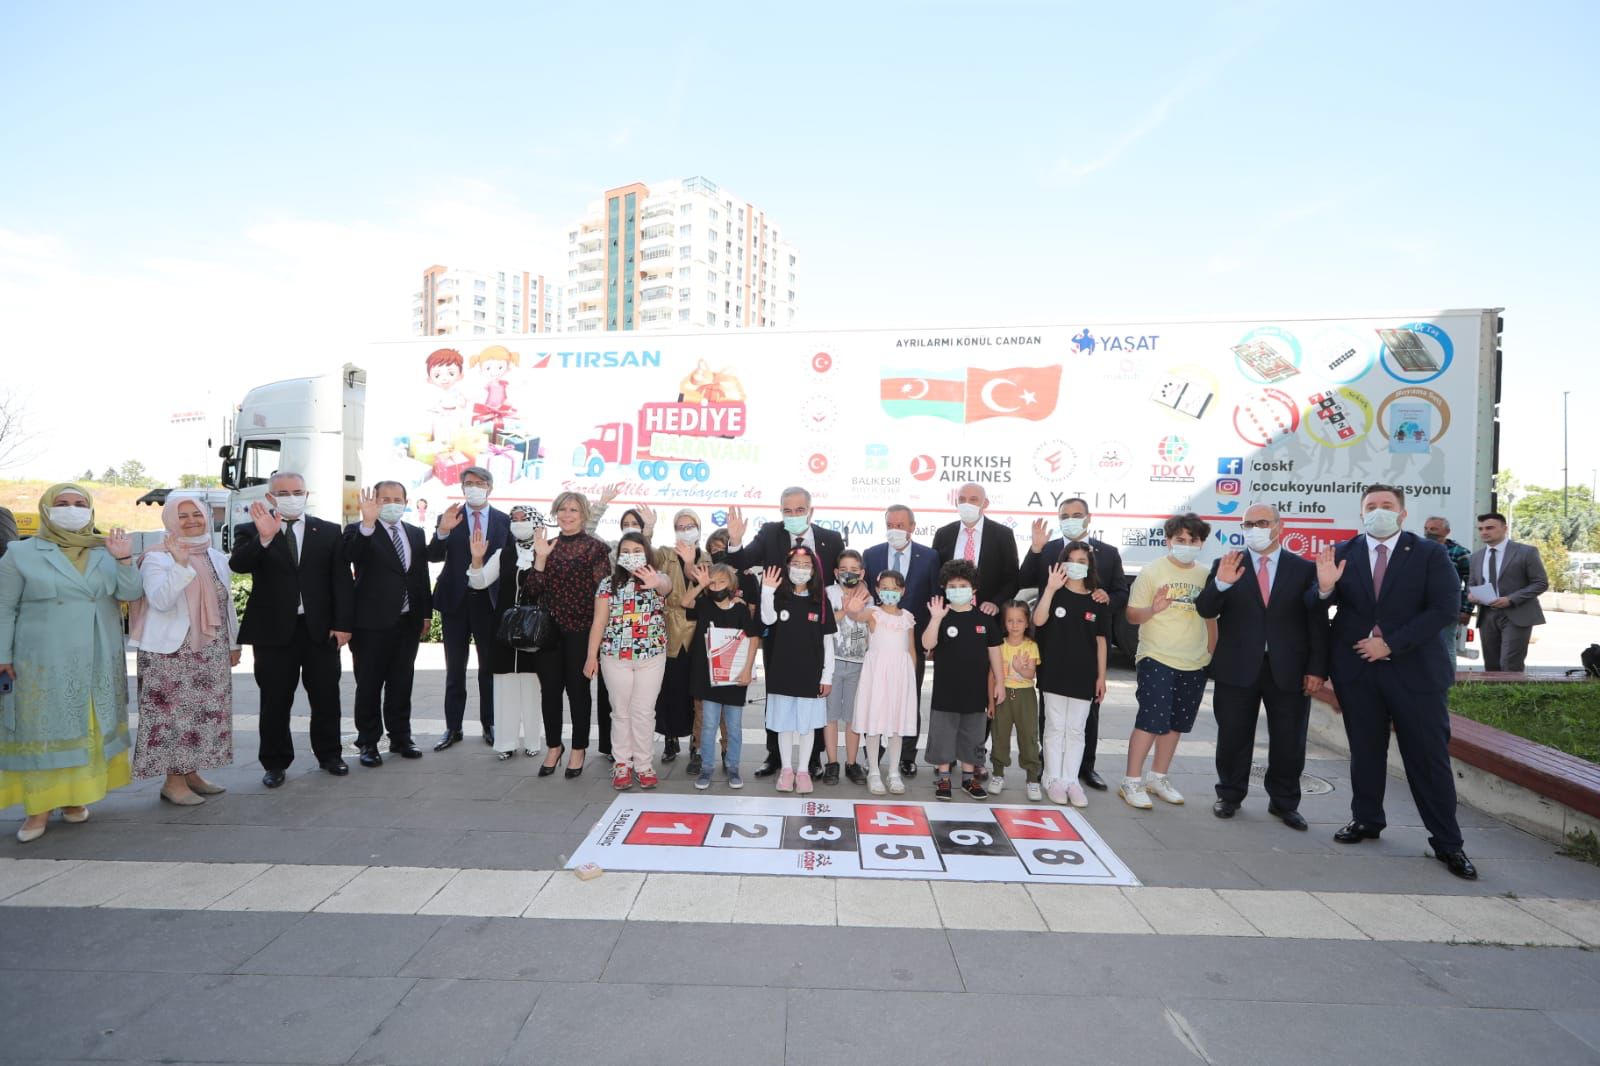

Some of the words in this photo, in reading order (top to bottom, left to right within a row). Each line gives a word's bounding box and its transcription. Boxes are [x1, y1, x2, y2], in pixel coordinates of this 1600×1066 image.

[896, 338, 953, 348] AYRILARMI
[996, 336, 1041, 345] CANDAN
[557, 351, 661, 368] TIRSAN
[645, 399, 742, 432] HEDİYE
[652, 435, 761, 463] KARAVANI
[941, 456, 1011, 469] TURKISH
[939, 470, 1012, 482] AIRLINES
[1249, 479, 1451, 497] /cocukoyunlarifeasyonu
[870, 811, 915, 827] 4
[1011, 817, 1063, 833] 7
[645, 822, 693, 835] 1
[720, 822, 769, 839] 2
[799, 825, 842, 841] 3
[949, 829, 994, 846] 6
[875, 843, 926, 860] 5
[1033, 848, 1085, 865] 8
